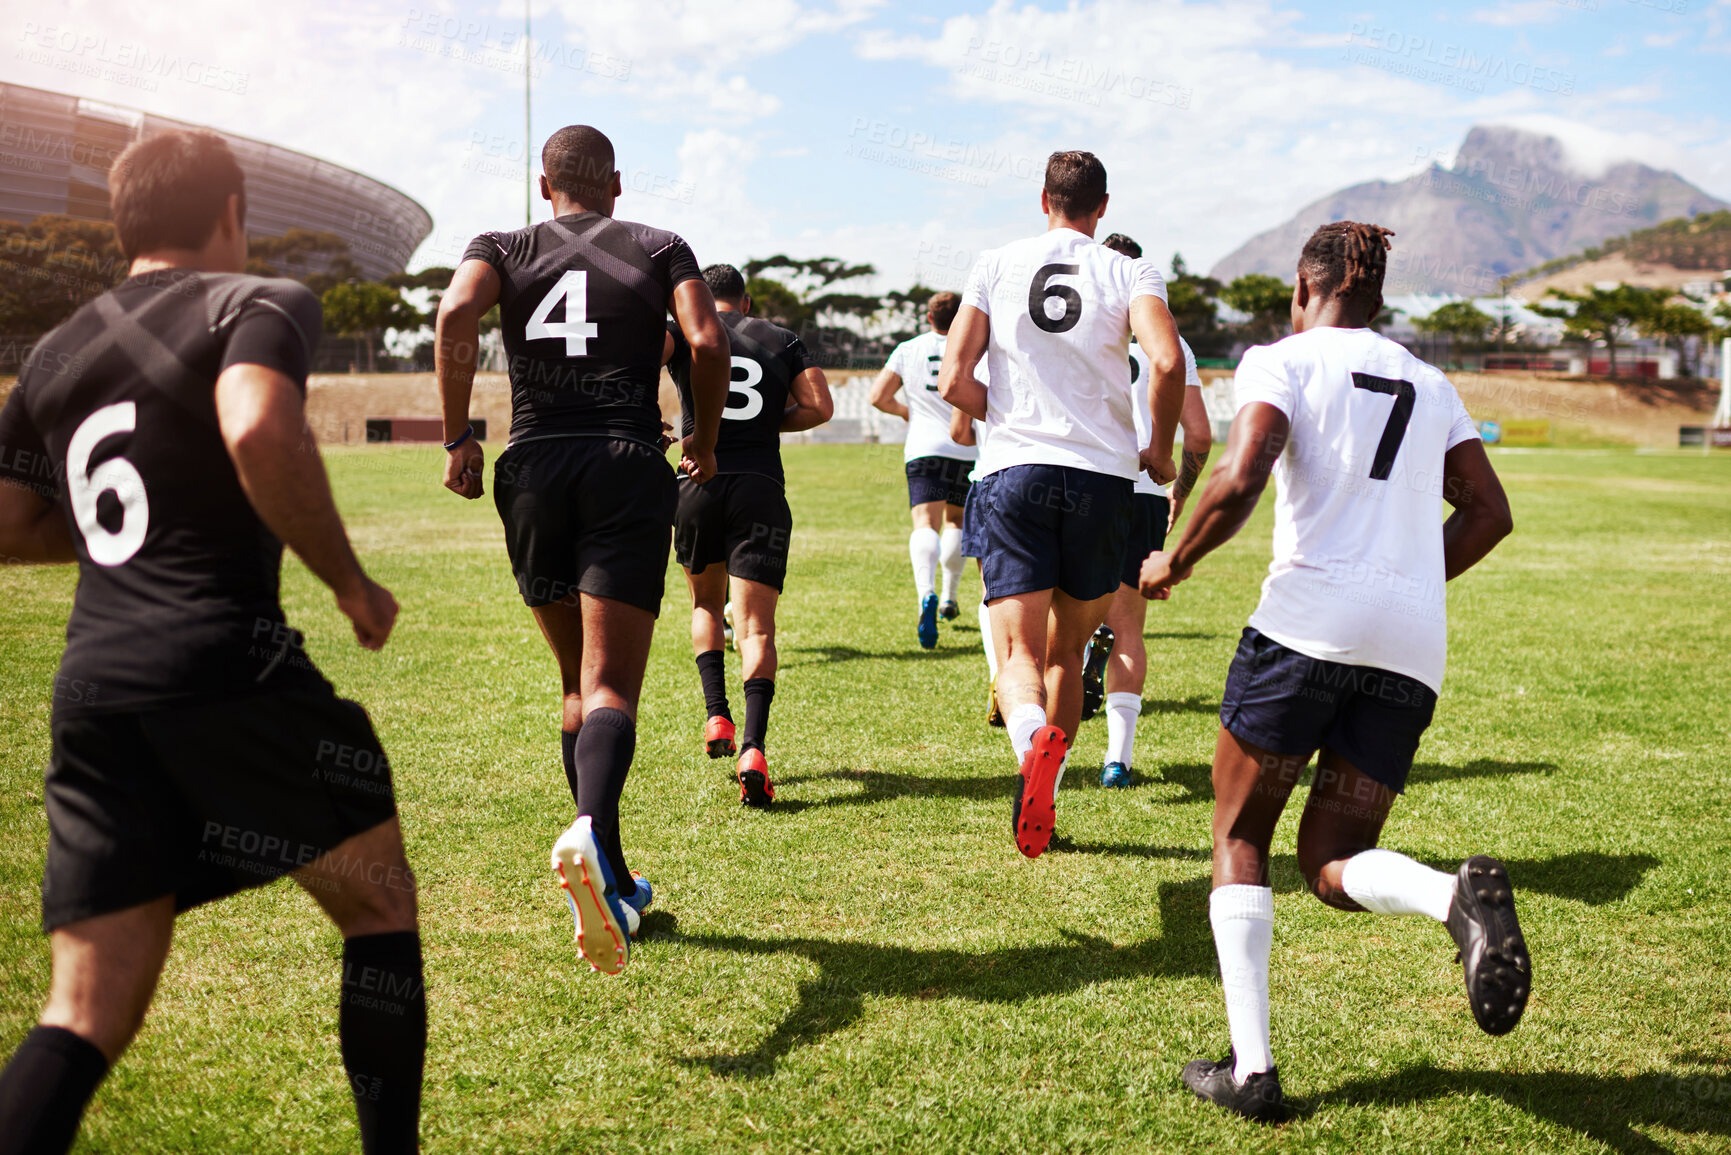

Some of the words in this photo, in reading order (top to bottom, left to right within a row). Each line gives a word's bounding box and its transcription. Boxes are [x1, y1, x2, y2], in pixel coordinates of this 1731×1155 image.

[525, 270, 598, 356] 4
[1028, 263, 1082, 333] 6
[1350, 372, 1416, 480] 7
[66, 400, 149, 567] 6
